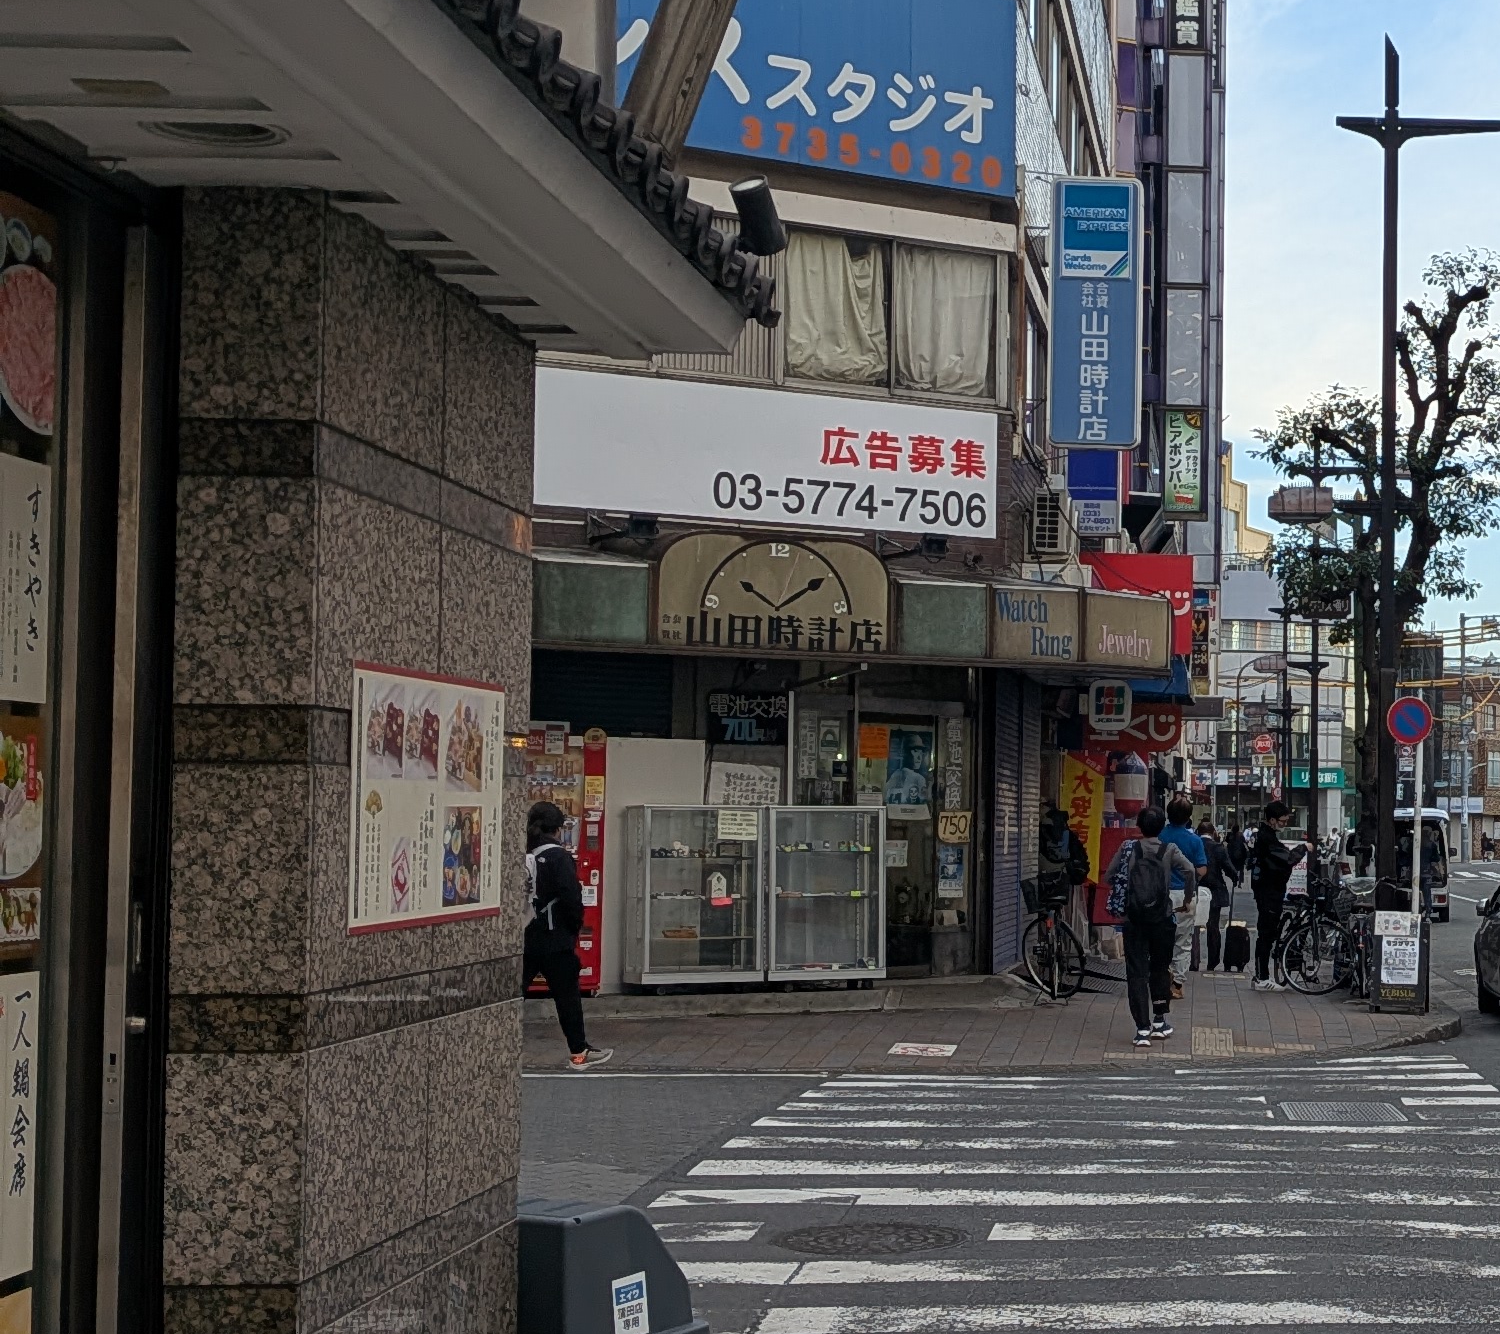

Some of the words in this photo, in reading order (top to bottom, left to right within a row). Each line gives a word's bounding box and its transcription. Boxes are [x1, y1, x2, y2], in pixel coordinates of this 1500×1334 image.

[742, 115, 1002, 187] 3735-0320
[1063, 207, 1126, 219] AMERICAN
[1077, 221, 1130, 232] EXPRESS
[1064, 253, 1092, 263] Cards
[1064, 262, 1107, 271] Welcome
[1078, 310, 1109, 442] 山田時計店
[820, 427, 988, 479] 広告募集
[712, 472, 988, 527] 03-5774-7506
[769, 542, 790, 558] 12
[24, 482, 42, 652] すきやき
[833, 600, 848, 614] 3
[996, 592, 1049, 624] Watch
[686, 613, 884, 652] 山田時計店
[1031, 626, 1073, 661] Ring
[1099, 624, 1153, 661] Jewelry
[709, 693, 787, 718] 電池交換
[940, 816, 968, 835] 750
[8, 989, 33, 1199] 一人鍋会席
[617, 1302, 644, 1320] 蒲田店
